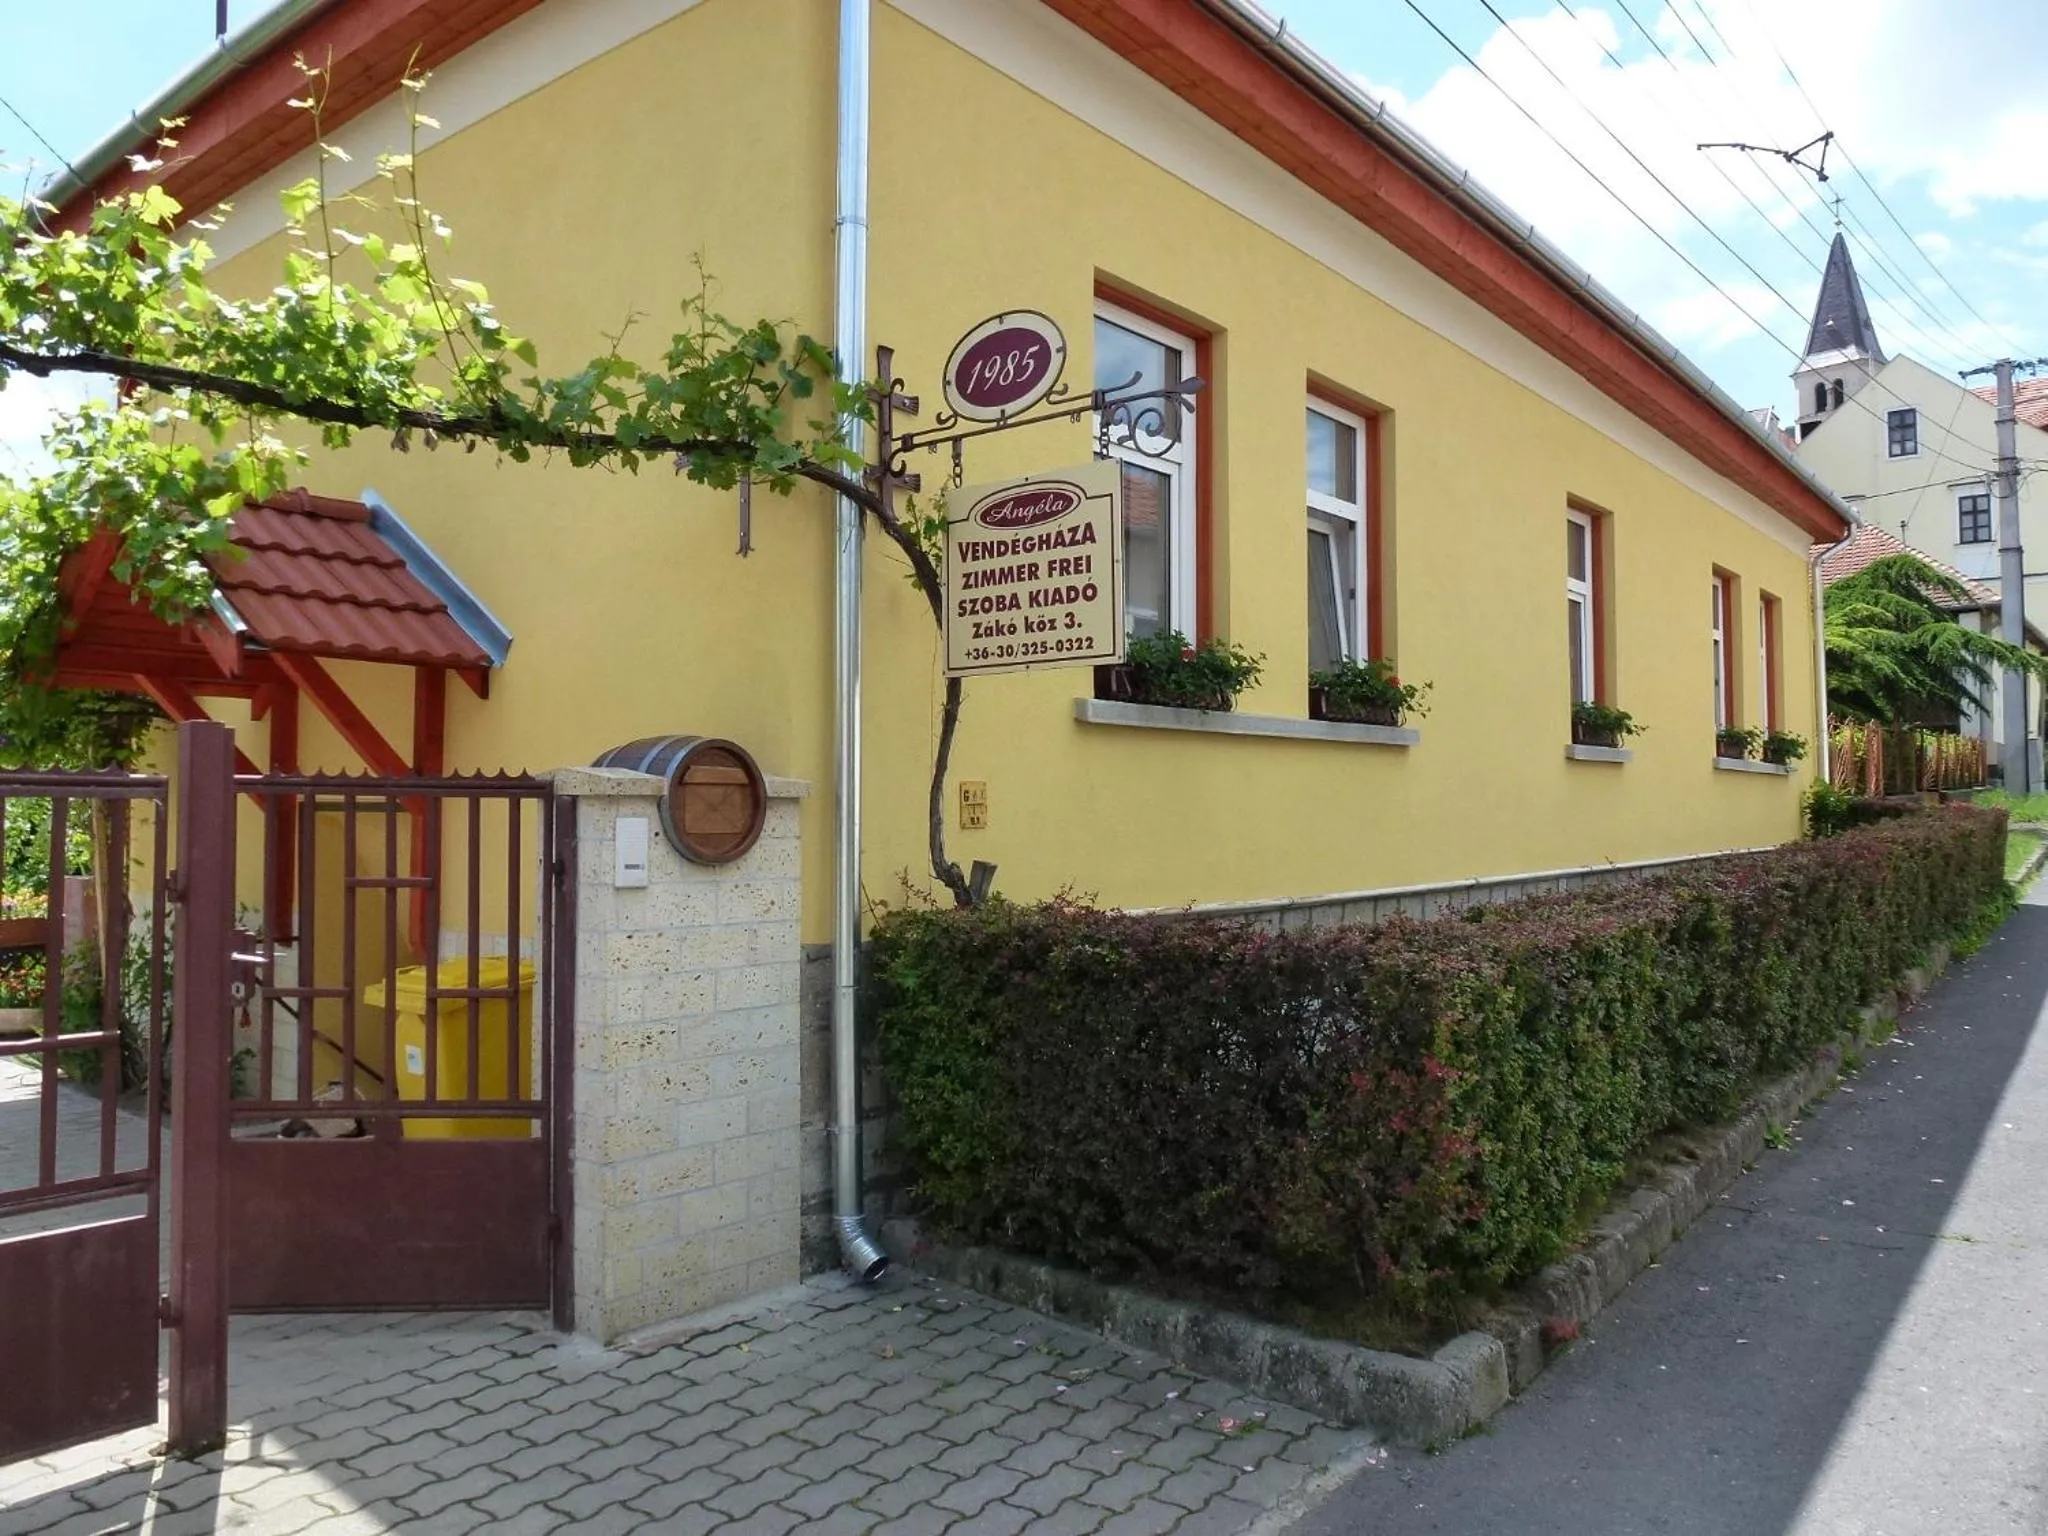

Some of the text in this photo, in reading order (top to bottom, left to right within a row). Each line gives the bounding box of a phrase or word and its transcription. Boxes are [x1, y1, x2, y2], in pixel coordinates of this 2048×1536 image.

[966, 344, 1040, 394] 1985
[987, 494, 1067, 523] Angéla
[957, 522, 1097, 563] VENDÉGHÁZA
[962, 555, 1092, 591] ZIMMER FREI
[957, 577, 1098, 618] SZOBA KIADÓ
[972, 611, 1083, 640] Zákó köz 3.
[964, 636, 1094, 660] +36-30/325-0322
